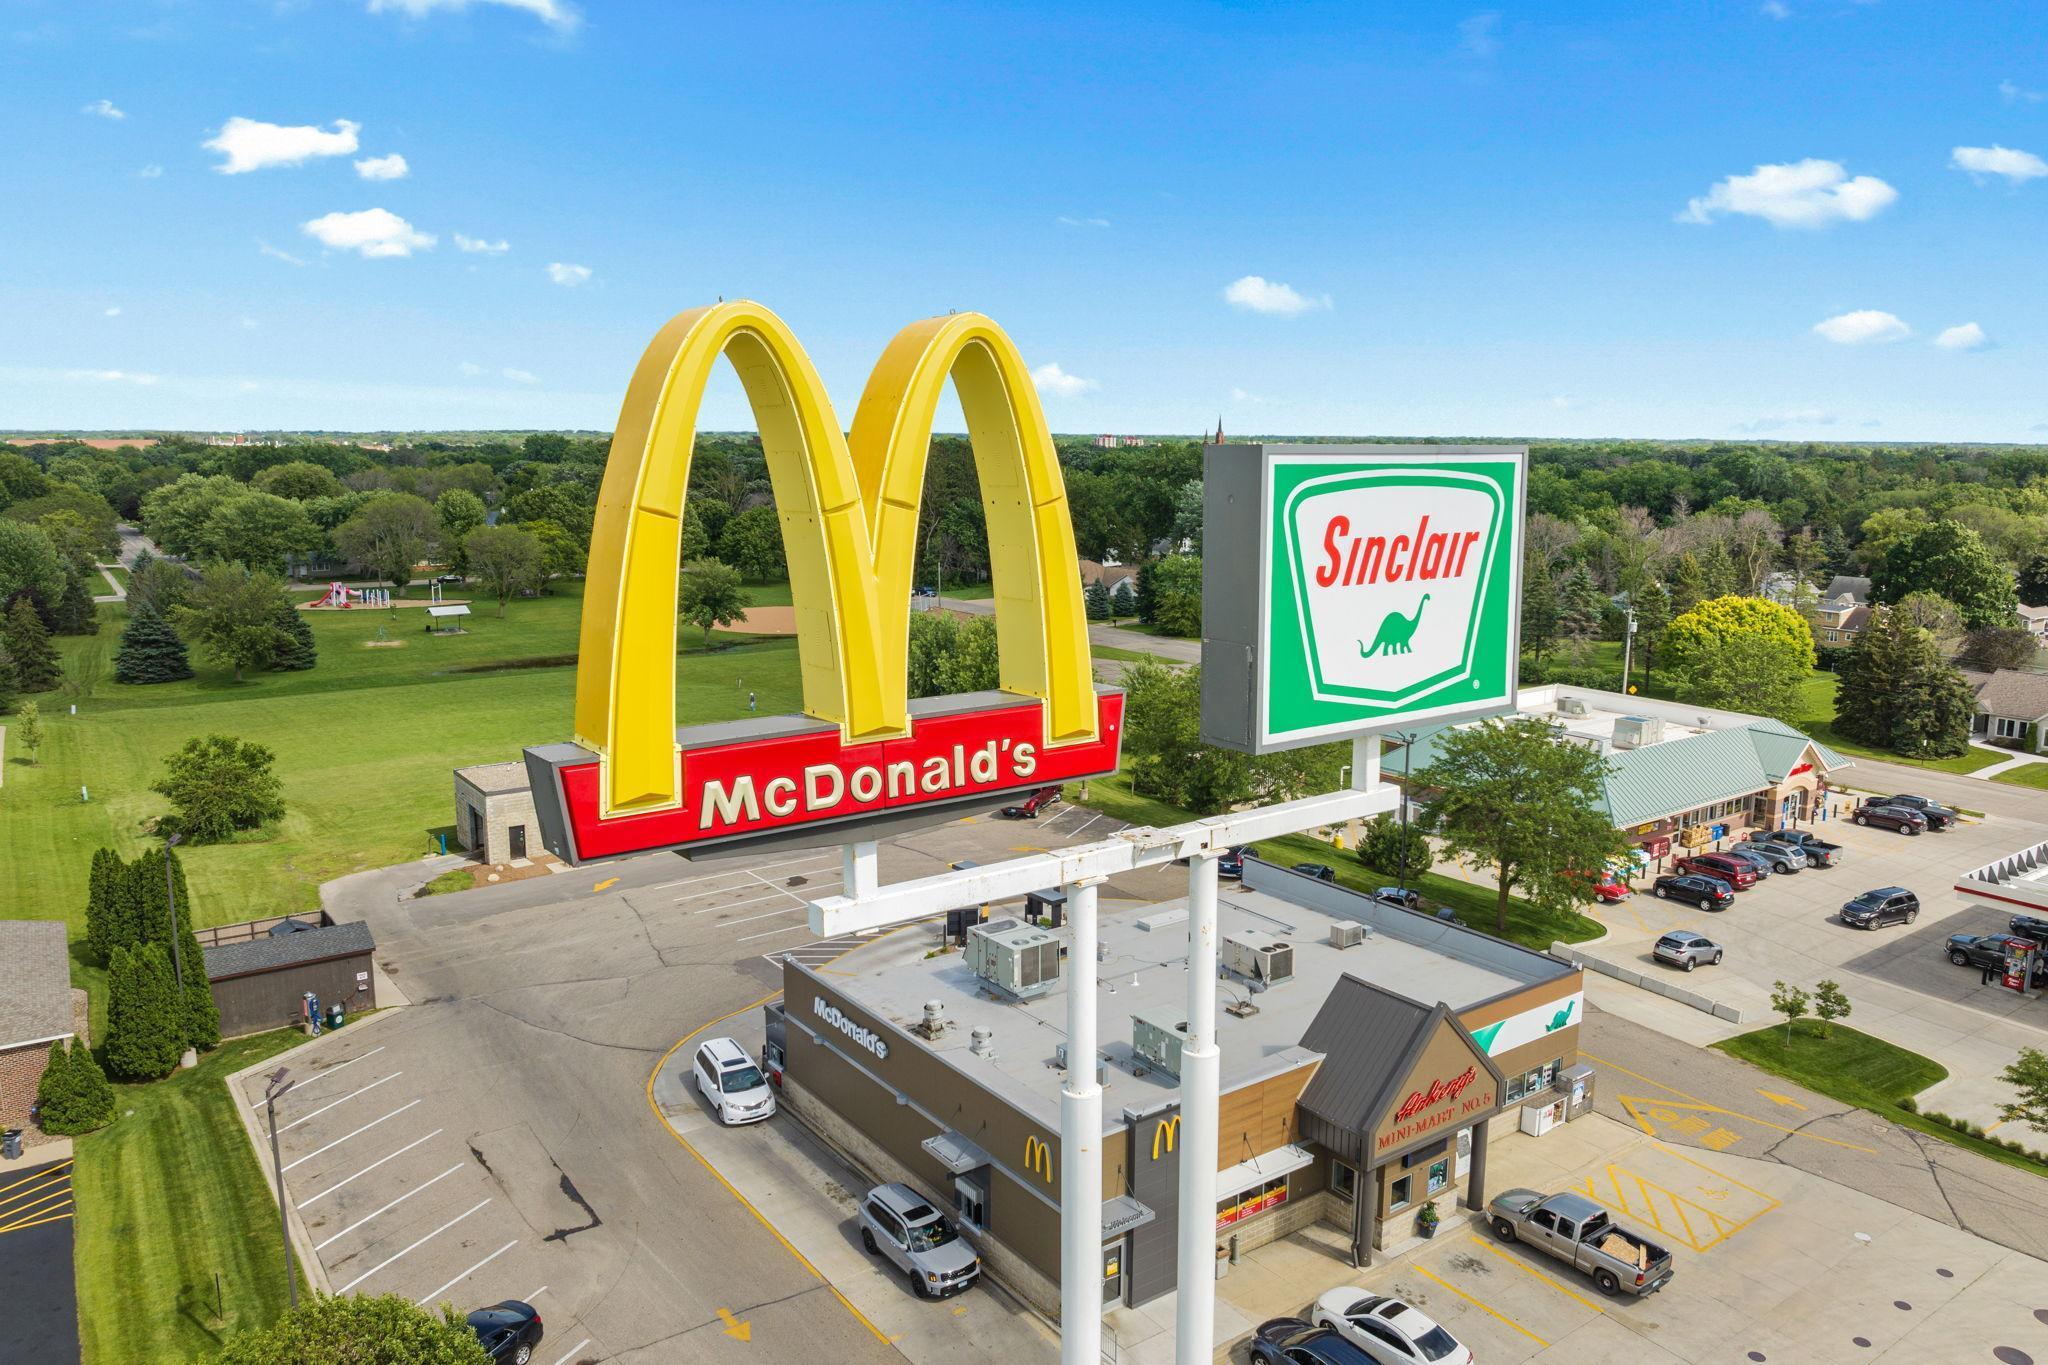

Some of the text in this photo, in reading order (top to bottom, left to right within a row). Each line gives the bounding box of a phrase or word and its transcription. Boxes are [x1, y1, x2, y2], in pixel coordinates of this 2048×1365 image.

[1315, 514, 1481, 588] Sinclair
[698, 737, 1038, 830] McDonald's
[812, 995, 889, 1060] McDonald's
[1377, 1108, 1456, 1150] MINI-MART
